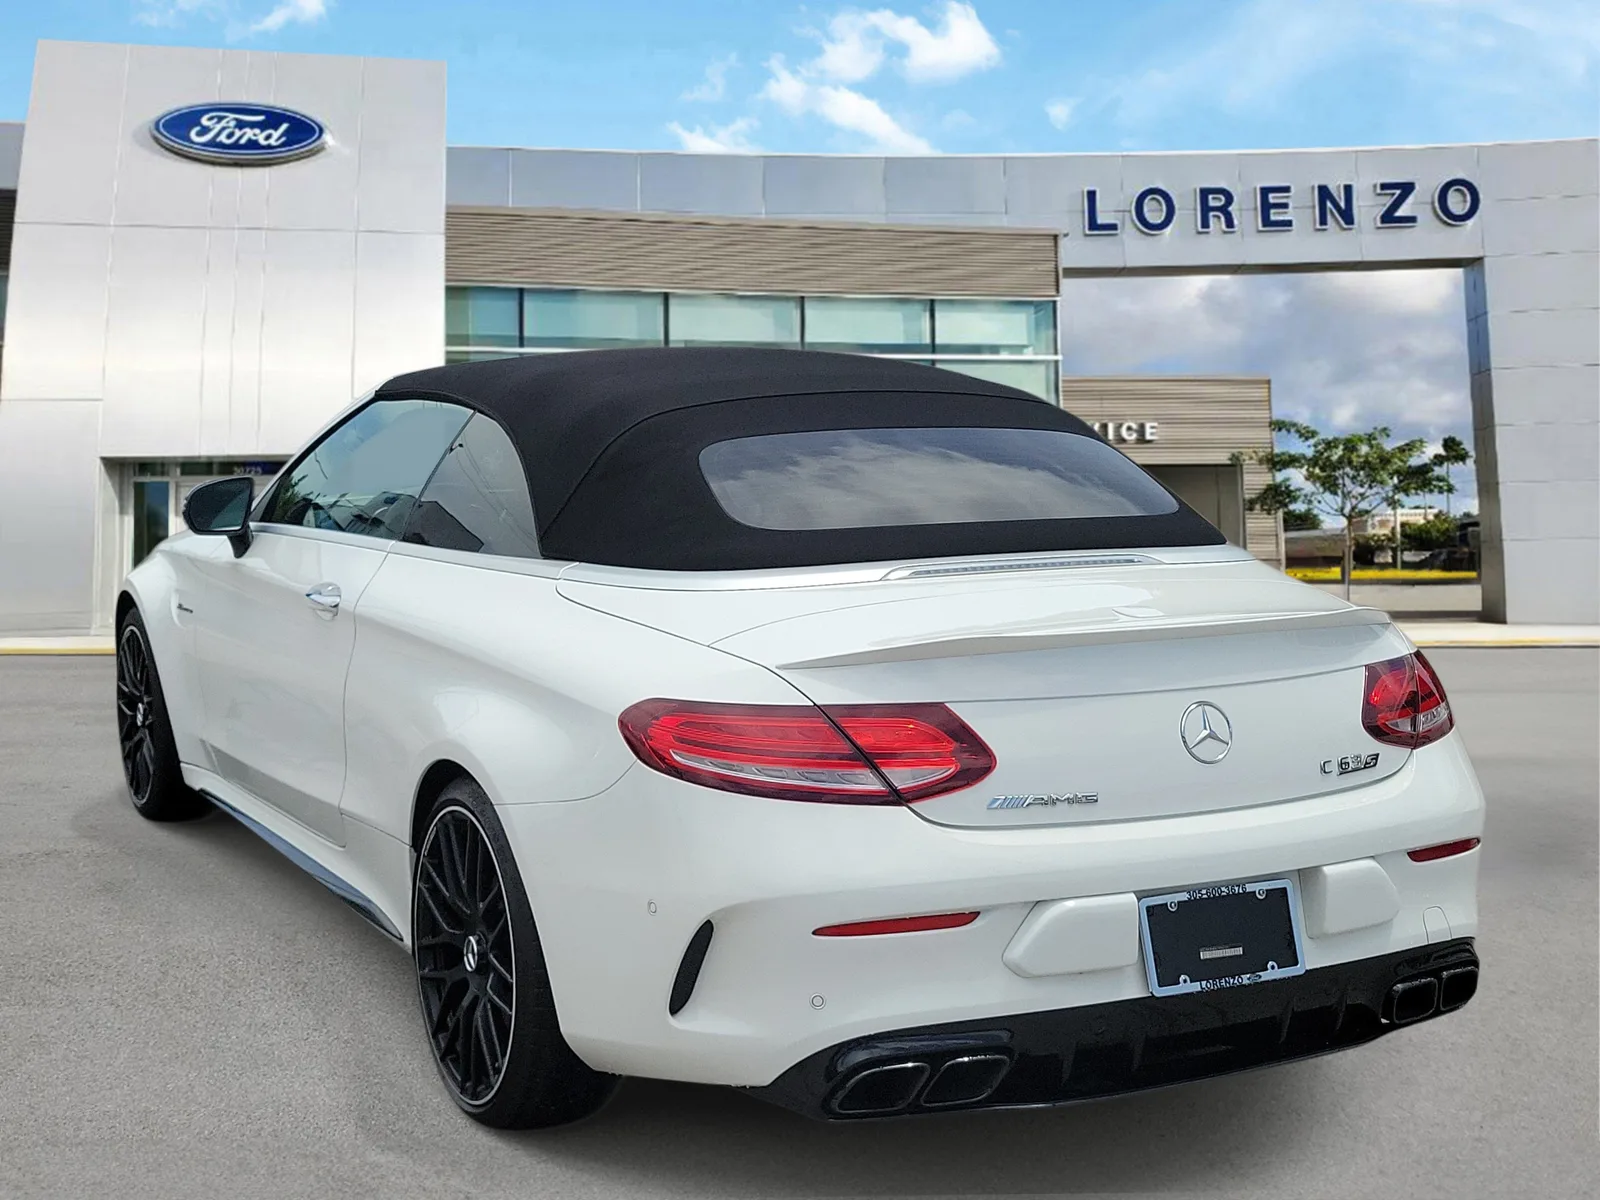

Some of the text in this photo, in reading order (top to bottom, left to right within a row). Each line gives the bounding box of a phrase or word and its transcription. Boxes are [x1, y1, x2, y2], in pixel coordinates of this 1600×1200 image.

[189, 111, 290, 146] Ford
[1083, 178, 1481, 235] LORENZO
[1200, 975, 1244, 991] LORENZO
